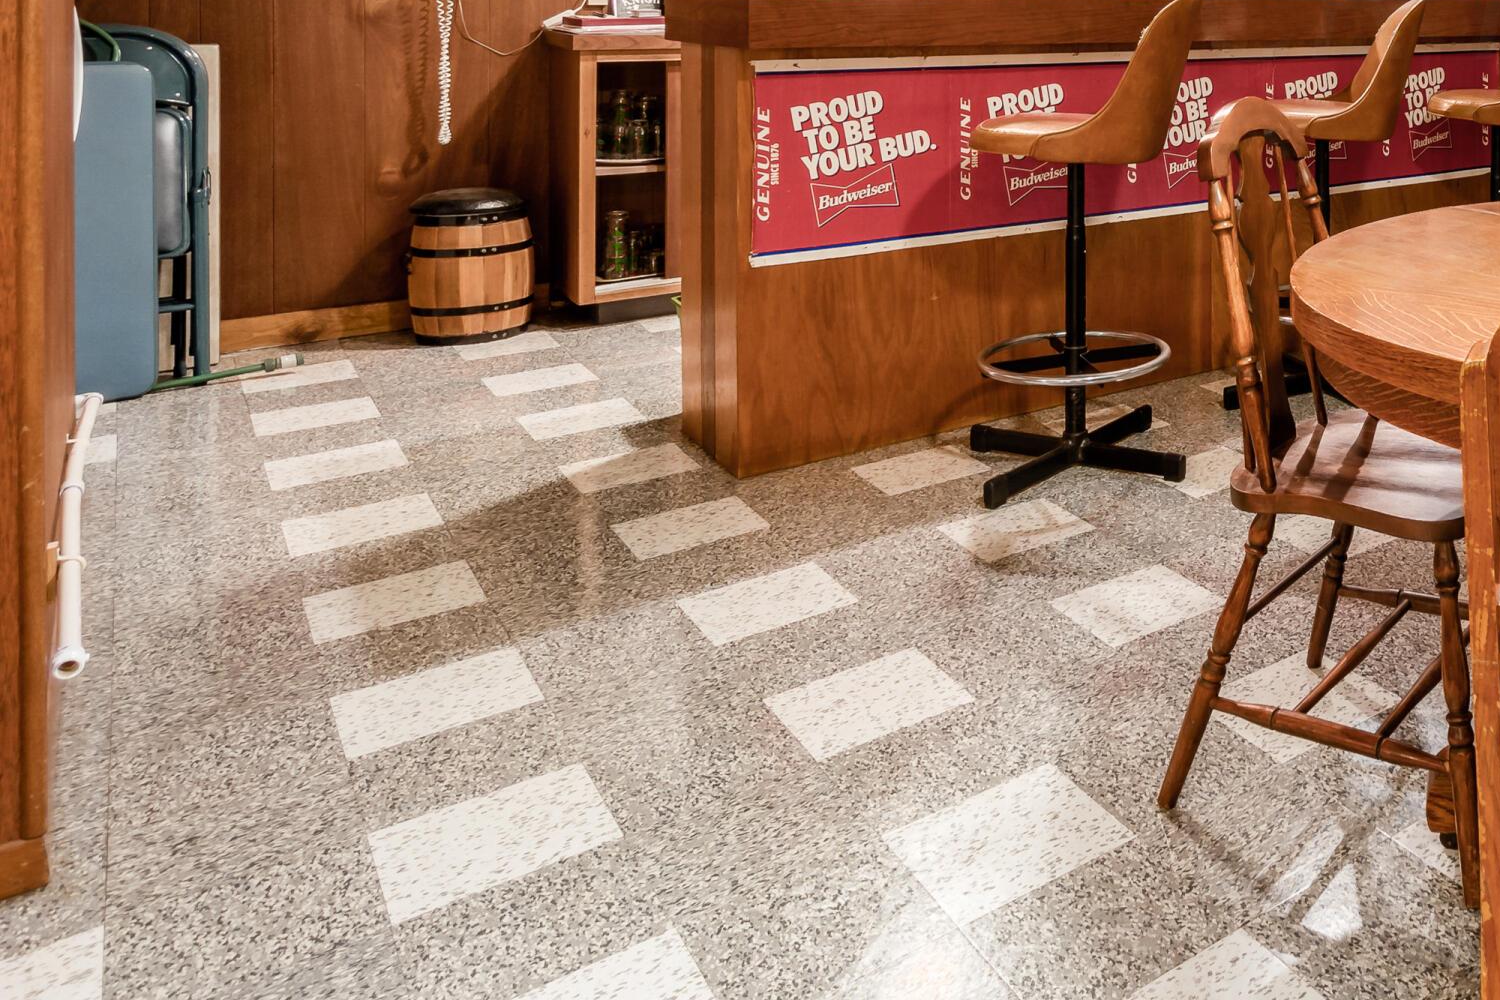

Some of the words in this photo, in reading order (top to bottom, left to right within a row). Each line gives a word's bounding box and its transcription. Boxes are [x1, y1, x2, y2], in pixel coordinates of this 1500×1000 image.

[1176, 76, 1213, 103] OUD
[1284, 71, 1338, 100] PROUD
[1405, 90, 1424, 110] TO
[790, 90, 884, 132] PROUD
[986, 83, 1064, 119] PROUD
[1185, 98, 1209, 122] BE
[1405, 106, 1441, 129] YOU
[802, 124, 840, 154] TO
[843, 115, 877, 146] BE
[960, 96, 971, 200] GENUINE
[1412, 131, 1450, 150] Budweiser
[756, 107, 770, 222] GENUINE
[771, 143, 780, 162] 1876
[801, 142, 876, 180] YOUR
[879, 129, 937, 163] BUD.
[771, 163, 780, 185] SINCE
[818, 181, 894, 210] Budweiser
